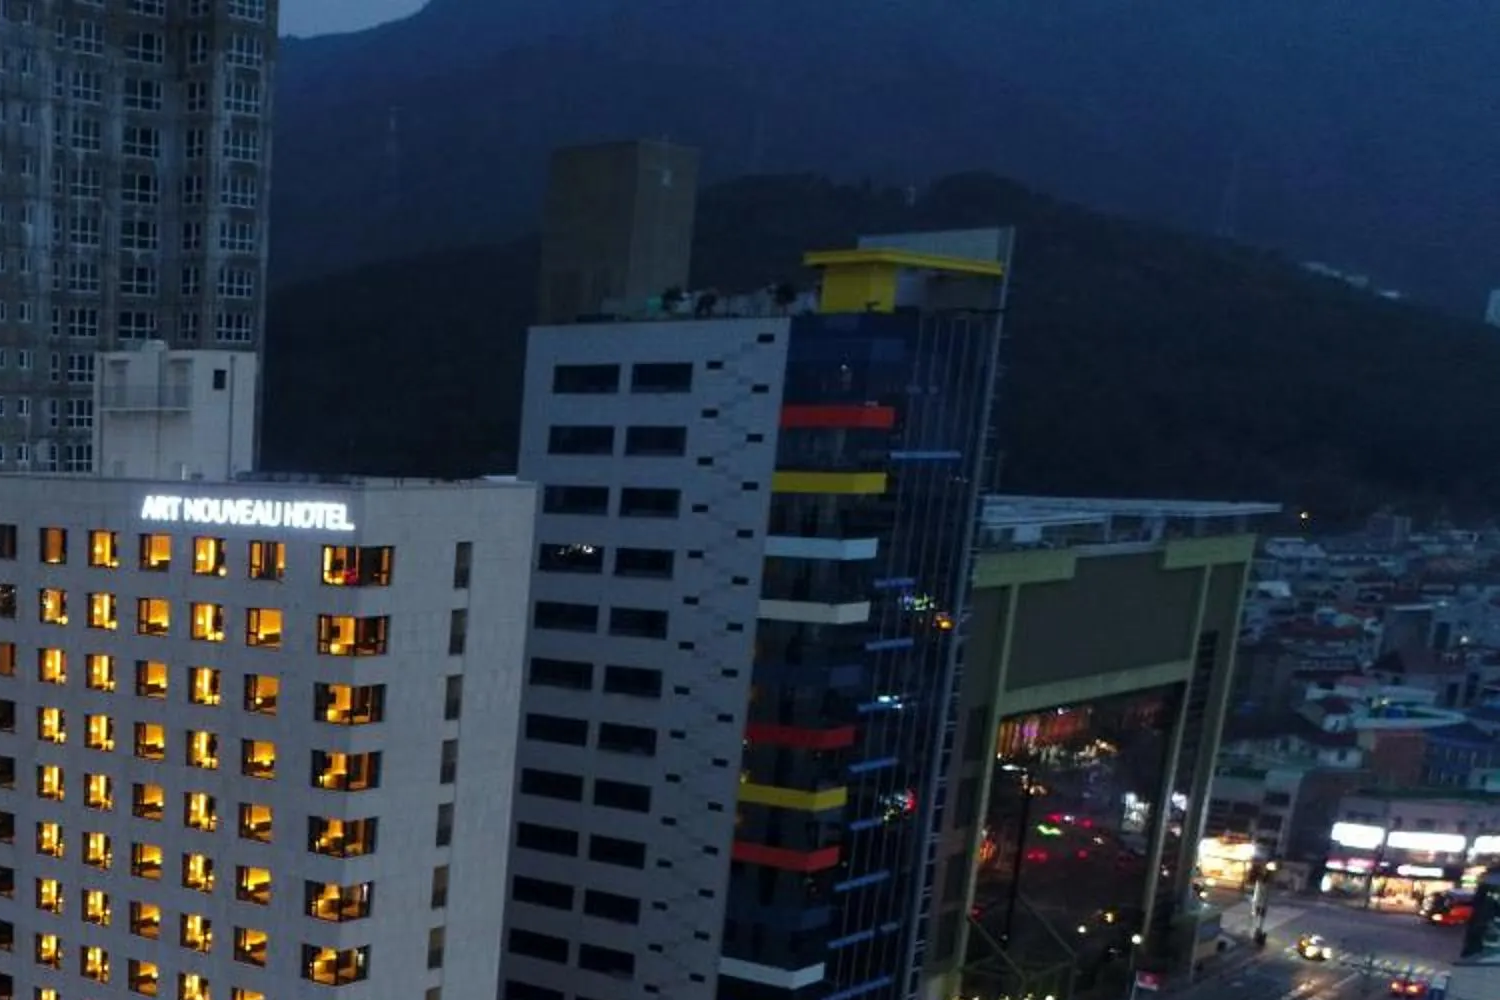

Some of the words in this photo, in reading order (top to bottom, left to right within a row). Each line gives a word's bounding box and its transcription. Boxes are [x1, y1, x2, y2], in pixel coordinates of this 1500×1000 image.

[141, 495, 182, 520] ART
[183, 497, 282, 525] NOUVEAU
[284, 501, 354, 530] HOTEL
